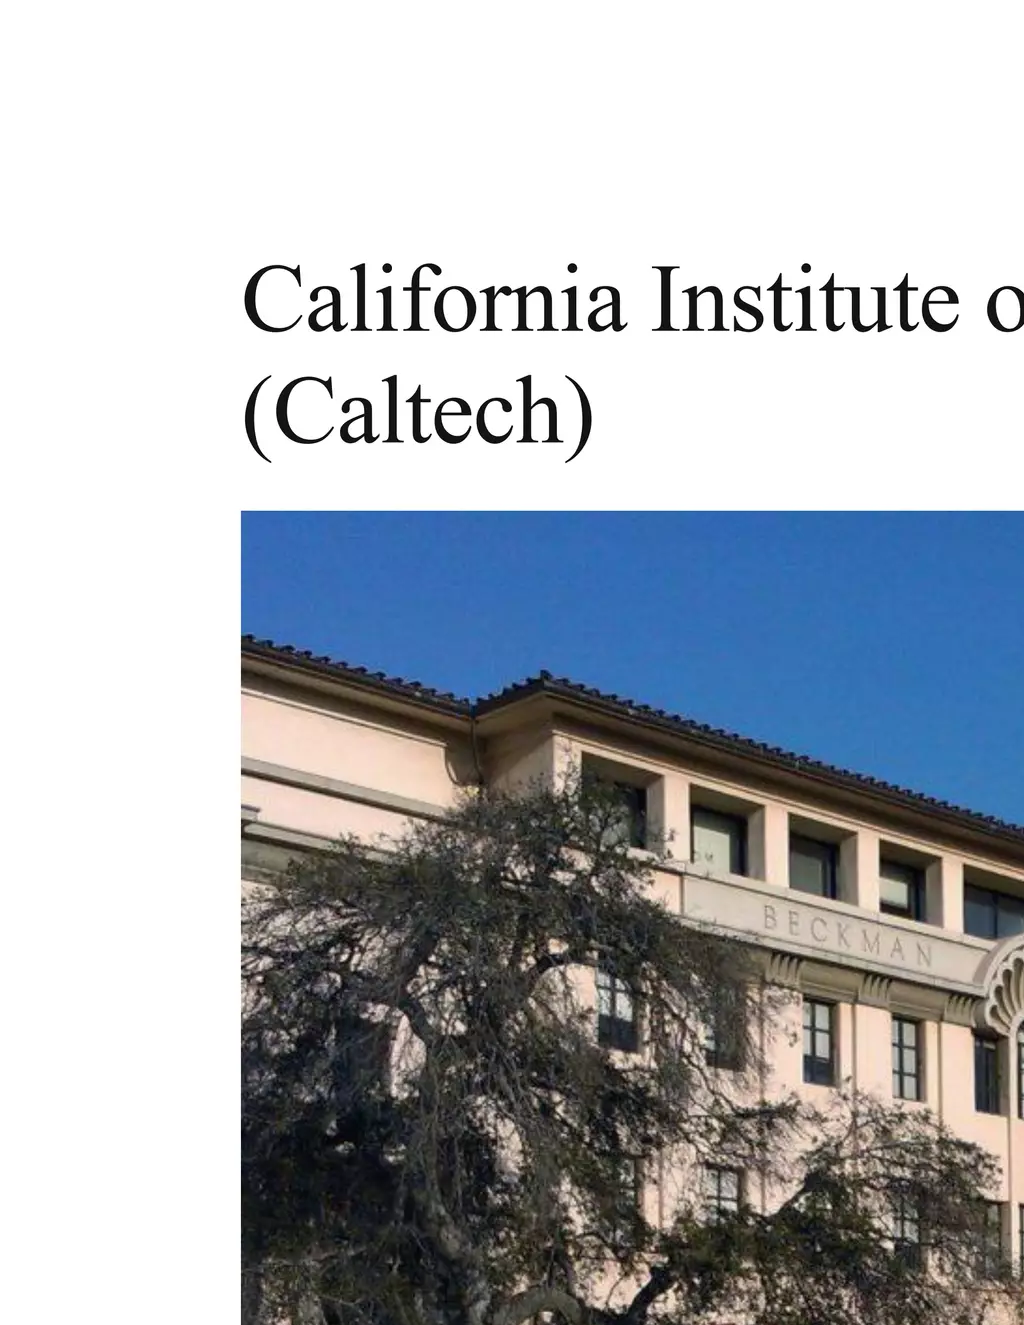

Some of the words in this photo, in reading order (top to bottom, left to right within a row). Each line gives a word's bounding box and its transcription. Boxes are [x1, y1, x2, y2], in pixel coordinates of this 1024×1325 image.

[244, 263, 627, 332] California
[652, 263, 959, 332] Institute
[245, 375, 592, 463] (Caltech)
[763, 904, 933, 968] BECKMAN
